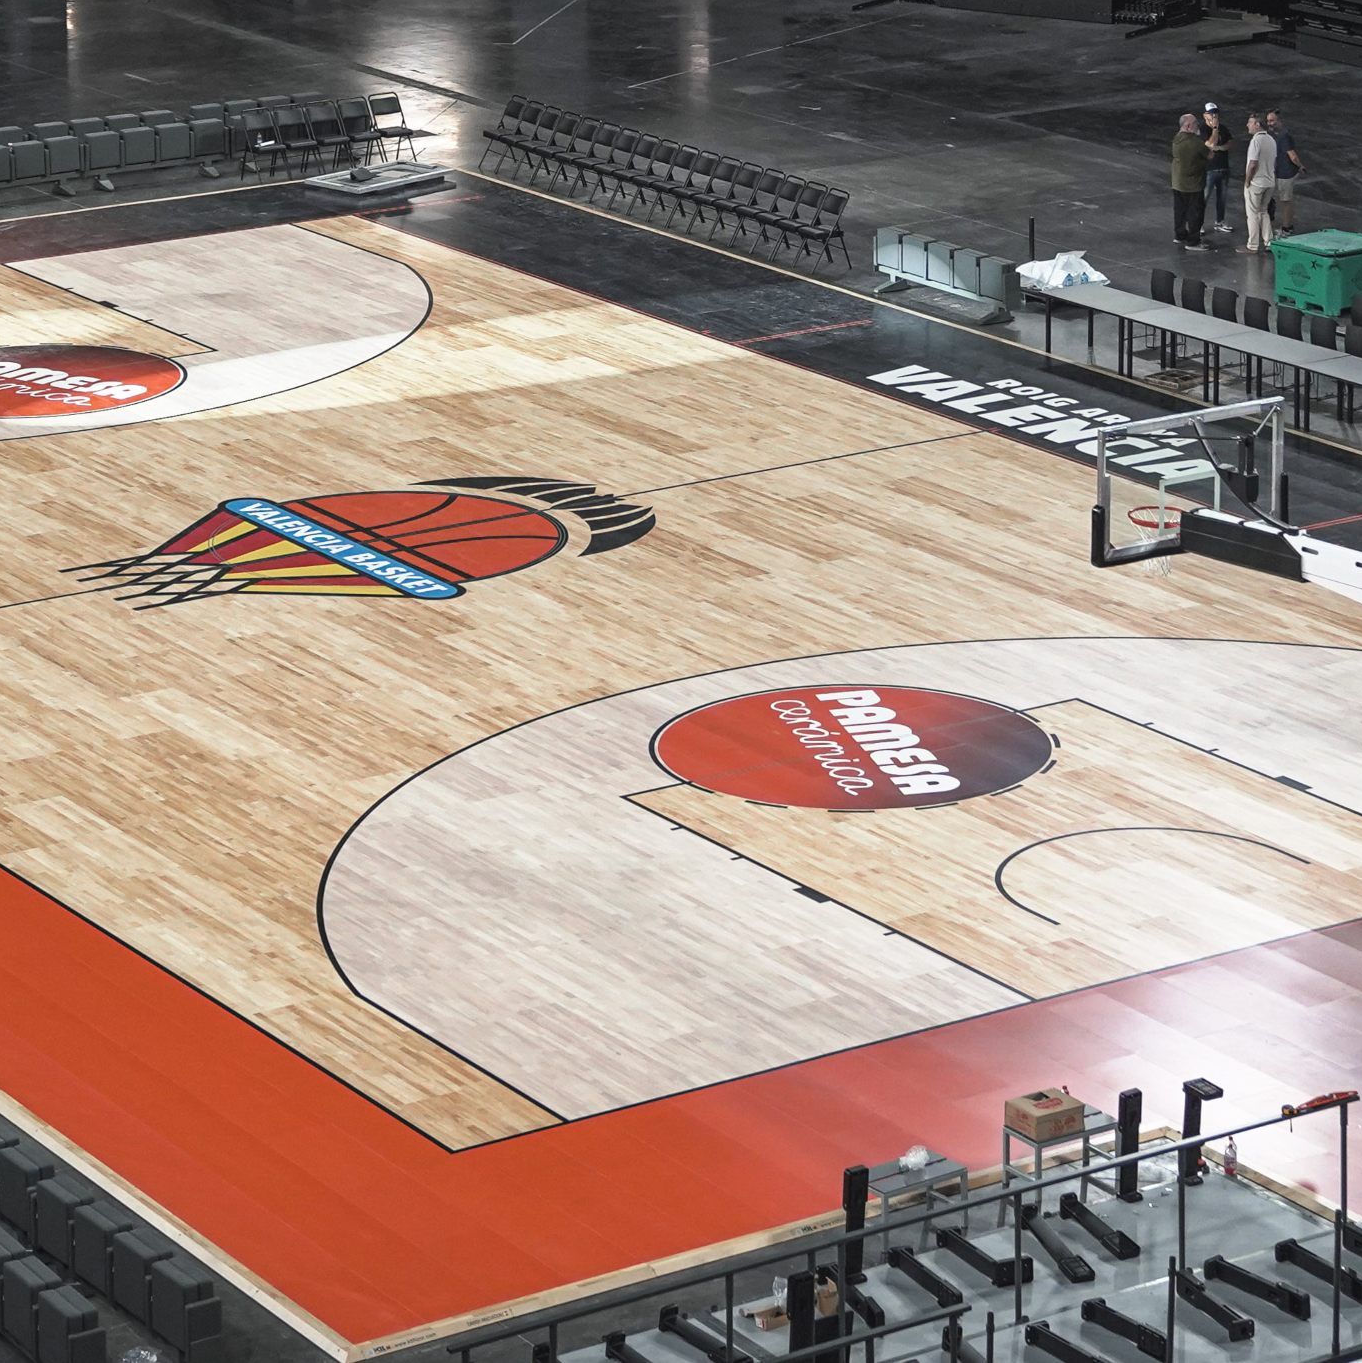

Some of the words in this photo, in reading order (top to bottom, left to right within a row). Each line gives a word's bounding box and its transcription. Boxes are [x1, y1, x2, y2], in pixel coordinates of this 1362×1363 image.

[865, 364, 1218, 480] VALENCIA
[985, 378, 1080, 408] ROIG
[239, 502, 355, 555] VALENCIA
[343, 552, 448, 594] BASKET
[815, 689, 961, 796] PAMESA
